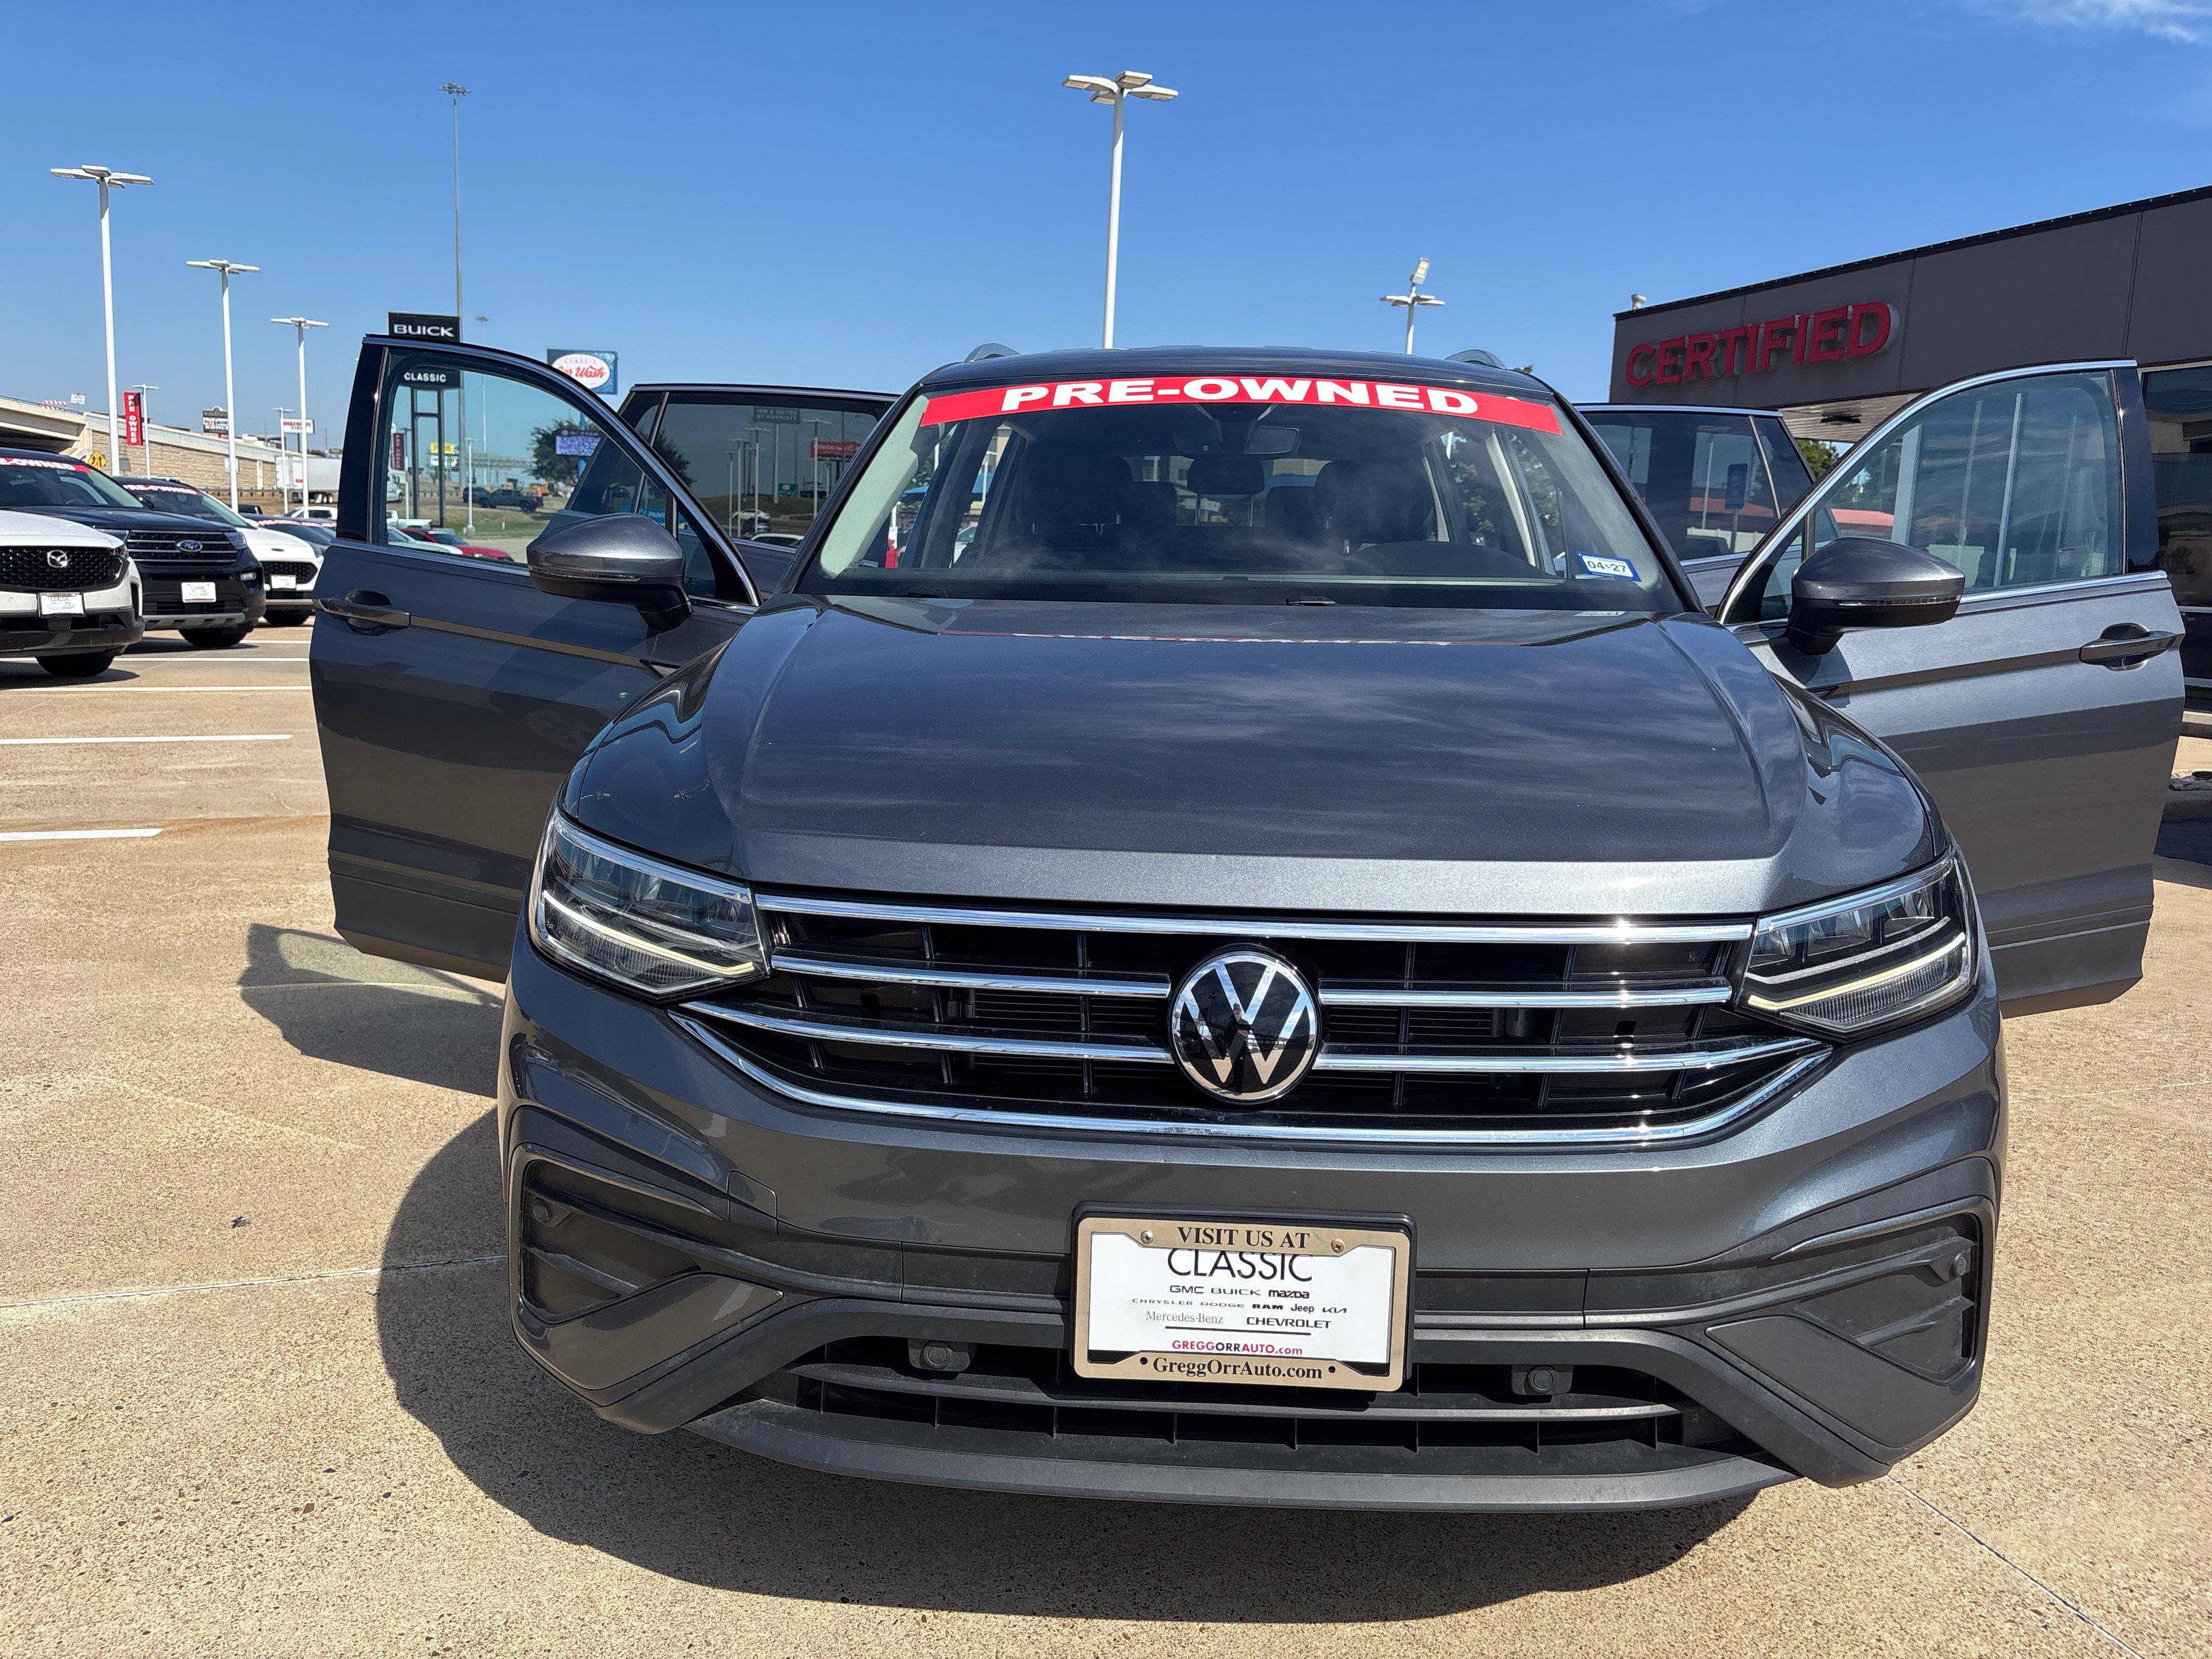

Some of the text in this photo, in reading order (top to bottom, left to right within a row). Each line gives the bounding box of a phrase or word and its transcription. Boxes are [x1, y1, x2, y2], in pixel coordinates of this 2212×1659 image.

[394, 324, 455, 337] BUICK
[1626, 301, 1898, 388] CERTIFIED
[404, 371, 447, 383] CLASSIC
[575, 365, 607, 379] Wash
[1001, 377, 1479, 415] PRE-OWNED
[128, 415, 137, 444] OWNED
[1177, 1227, 1310, 1249] VISIT US AT
[1167, 1248, 1313, 1282] CLASSIC
[1170, 1285, 1310, 1299] GMC BUICK mazda
[1290, 1303, 1315, 1314] Jeep
[1146, 1311, 1332, 1329] Mercedes-Benz CHEVROLET
[1172, 1340, 1303, 1355] GREGGORRAUTO.com
[1153, 1357, 1323, 1379] GreggOrrAuto.com
